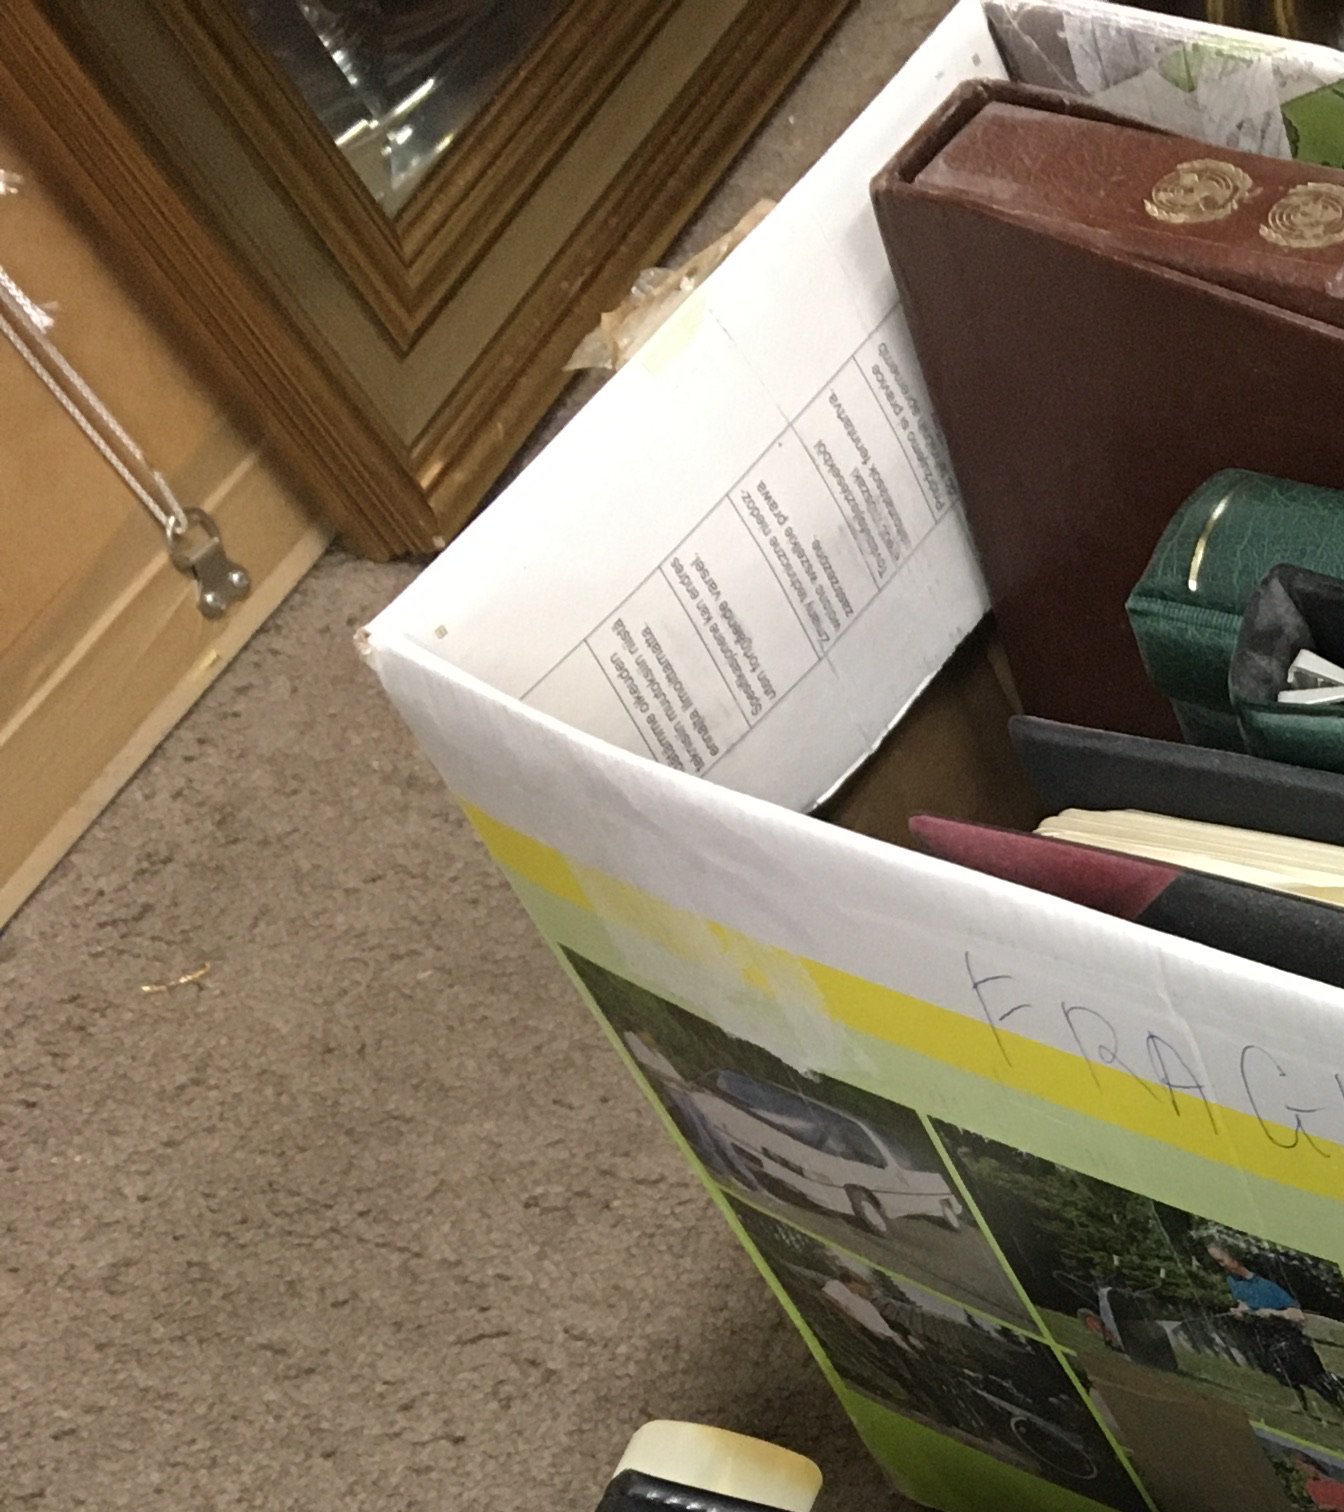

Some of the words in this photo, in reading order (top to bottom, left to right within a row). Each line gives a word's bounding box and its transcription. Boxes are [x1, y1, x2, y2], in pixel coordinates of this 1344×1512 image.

[870, 362, 903, 417] pravice
[737, 485, 771, 539] niedoz-
[755, 479, 788, 528] prawa
[669, 555, 699, 604] endres
[688, 551, 721, 603] varsel.
[767, 534, 807, 605] techniczne
[781, 524, 818, 586] wszelkie
[694, 599, 713, 626] kan
[608, 650, 650, 717] oikeuden
[633, 654, 676, 725] muutoksiin
[755, 669, 776, 702] uten
[687, 708, 719, 759] ennalta
